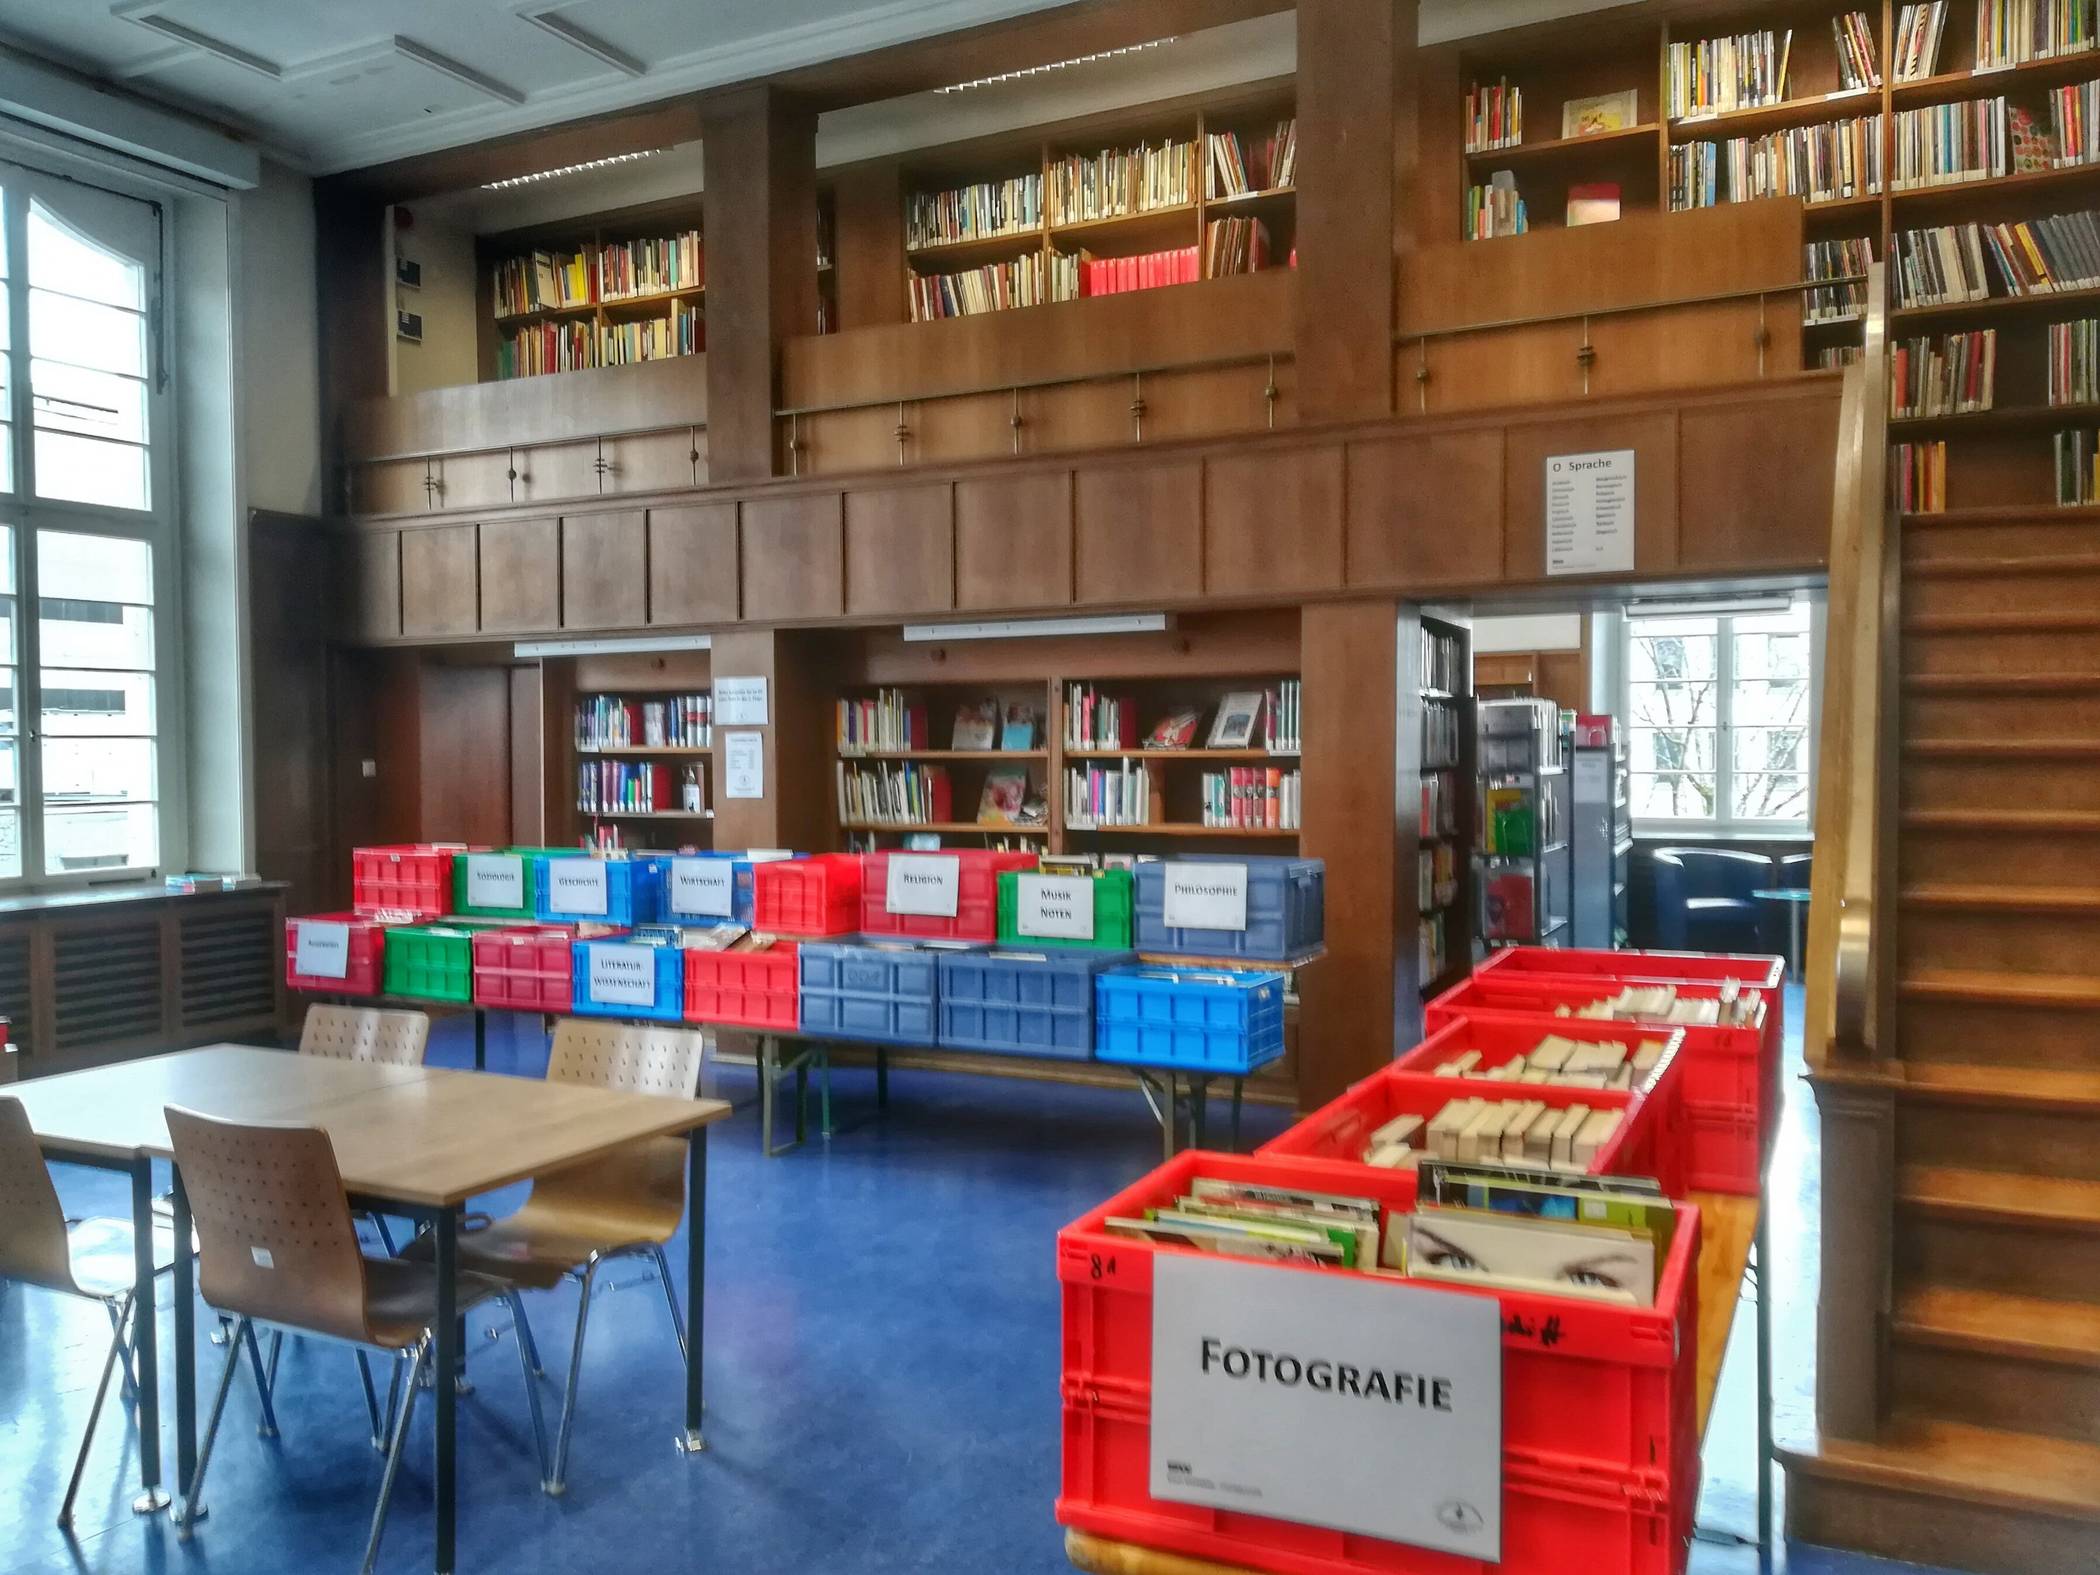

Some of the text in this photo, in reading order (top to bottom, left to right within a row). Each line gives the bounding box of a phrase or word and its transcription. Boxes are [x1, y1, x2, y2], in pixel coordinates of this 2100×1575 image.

[1569, 458, 1612, 472] Sprache
[1041, 889, 1072, 901] MUSIK
[1174, 883, 1238, 896] PHILOSOPHIE
[1041, 907, 1072, 920] NOTEN
[1201, 1336, 1453, 1413] FOTOGRAFIE
